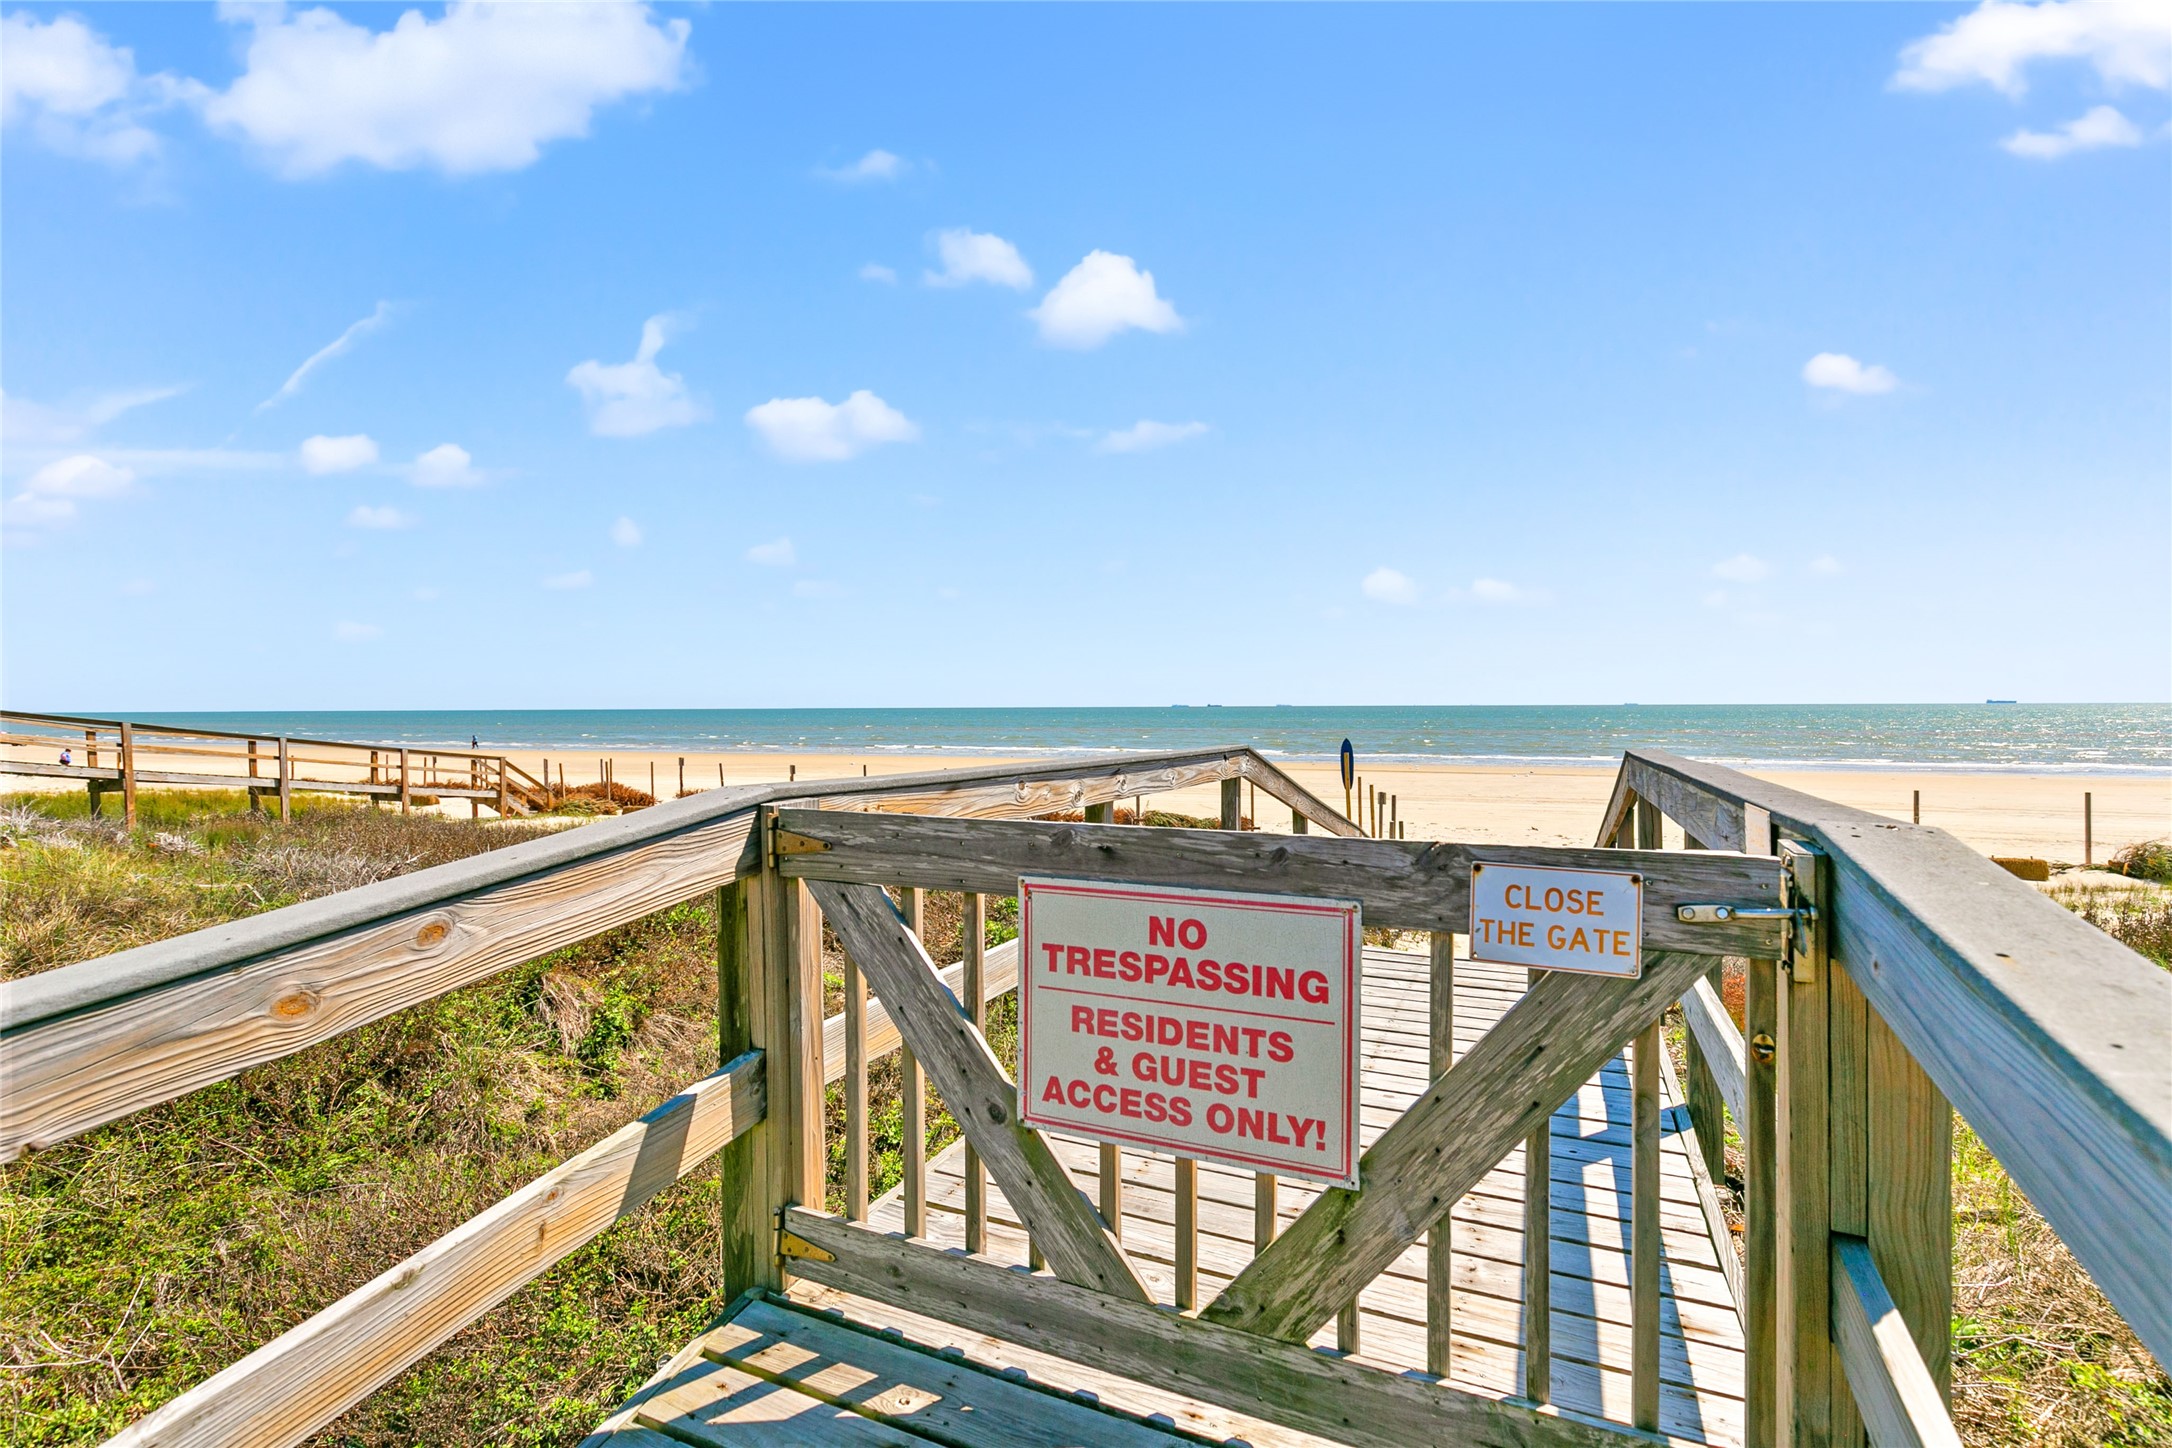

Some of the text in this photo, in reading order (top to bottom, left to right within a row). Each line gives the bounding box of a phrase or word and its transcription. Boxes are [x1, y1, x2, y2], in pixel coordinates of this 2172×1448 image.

[1504, 884, 1604, 916] CLOSE
[1149, 915, 1207, 950] NO
[1479, 918, 1631, 957] THE GATE
[1042, 942, 1329, 1005] TRESPASSING
[1071, 1005, 1294, 1063] RESIDENTS
[1094, 1046, 1265, 1099] & GUEST
[1041, 1075, 1326, 1151] ACCESS ONLY!
